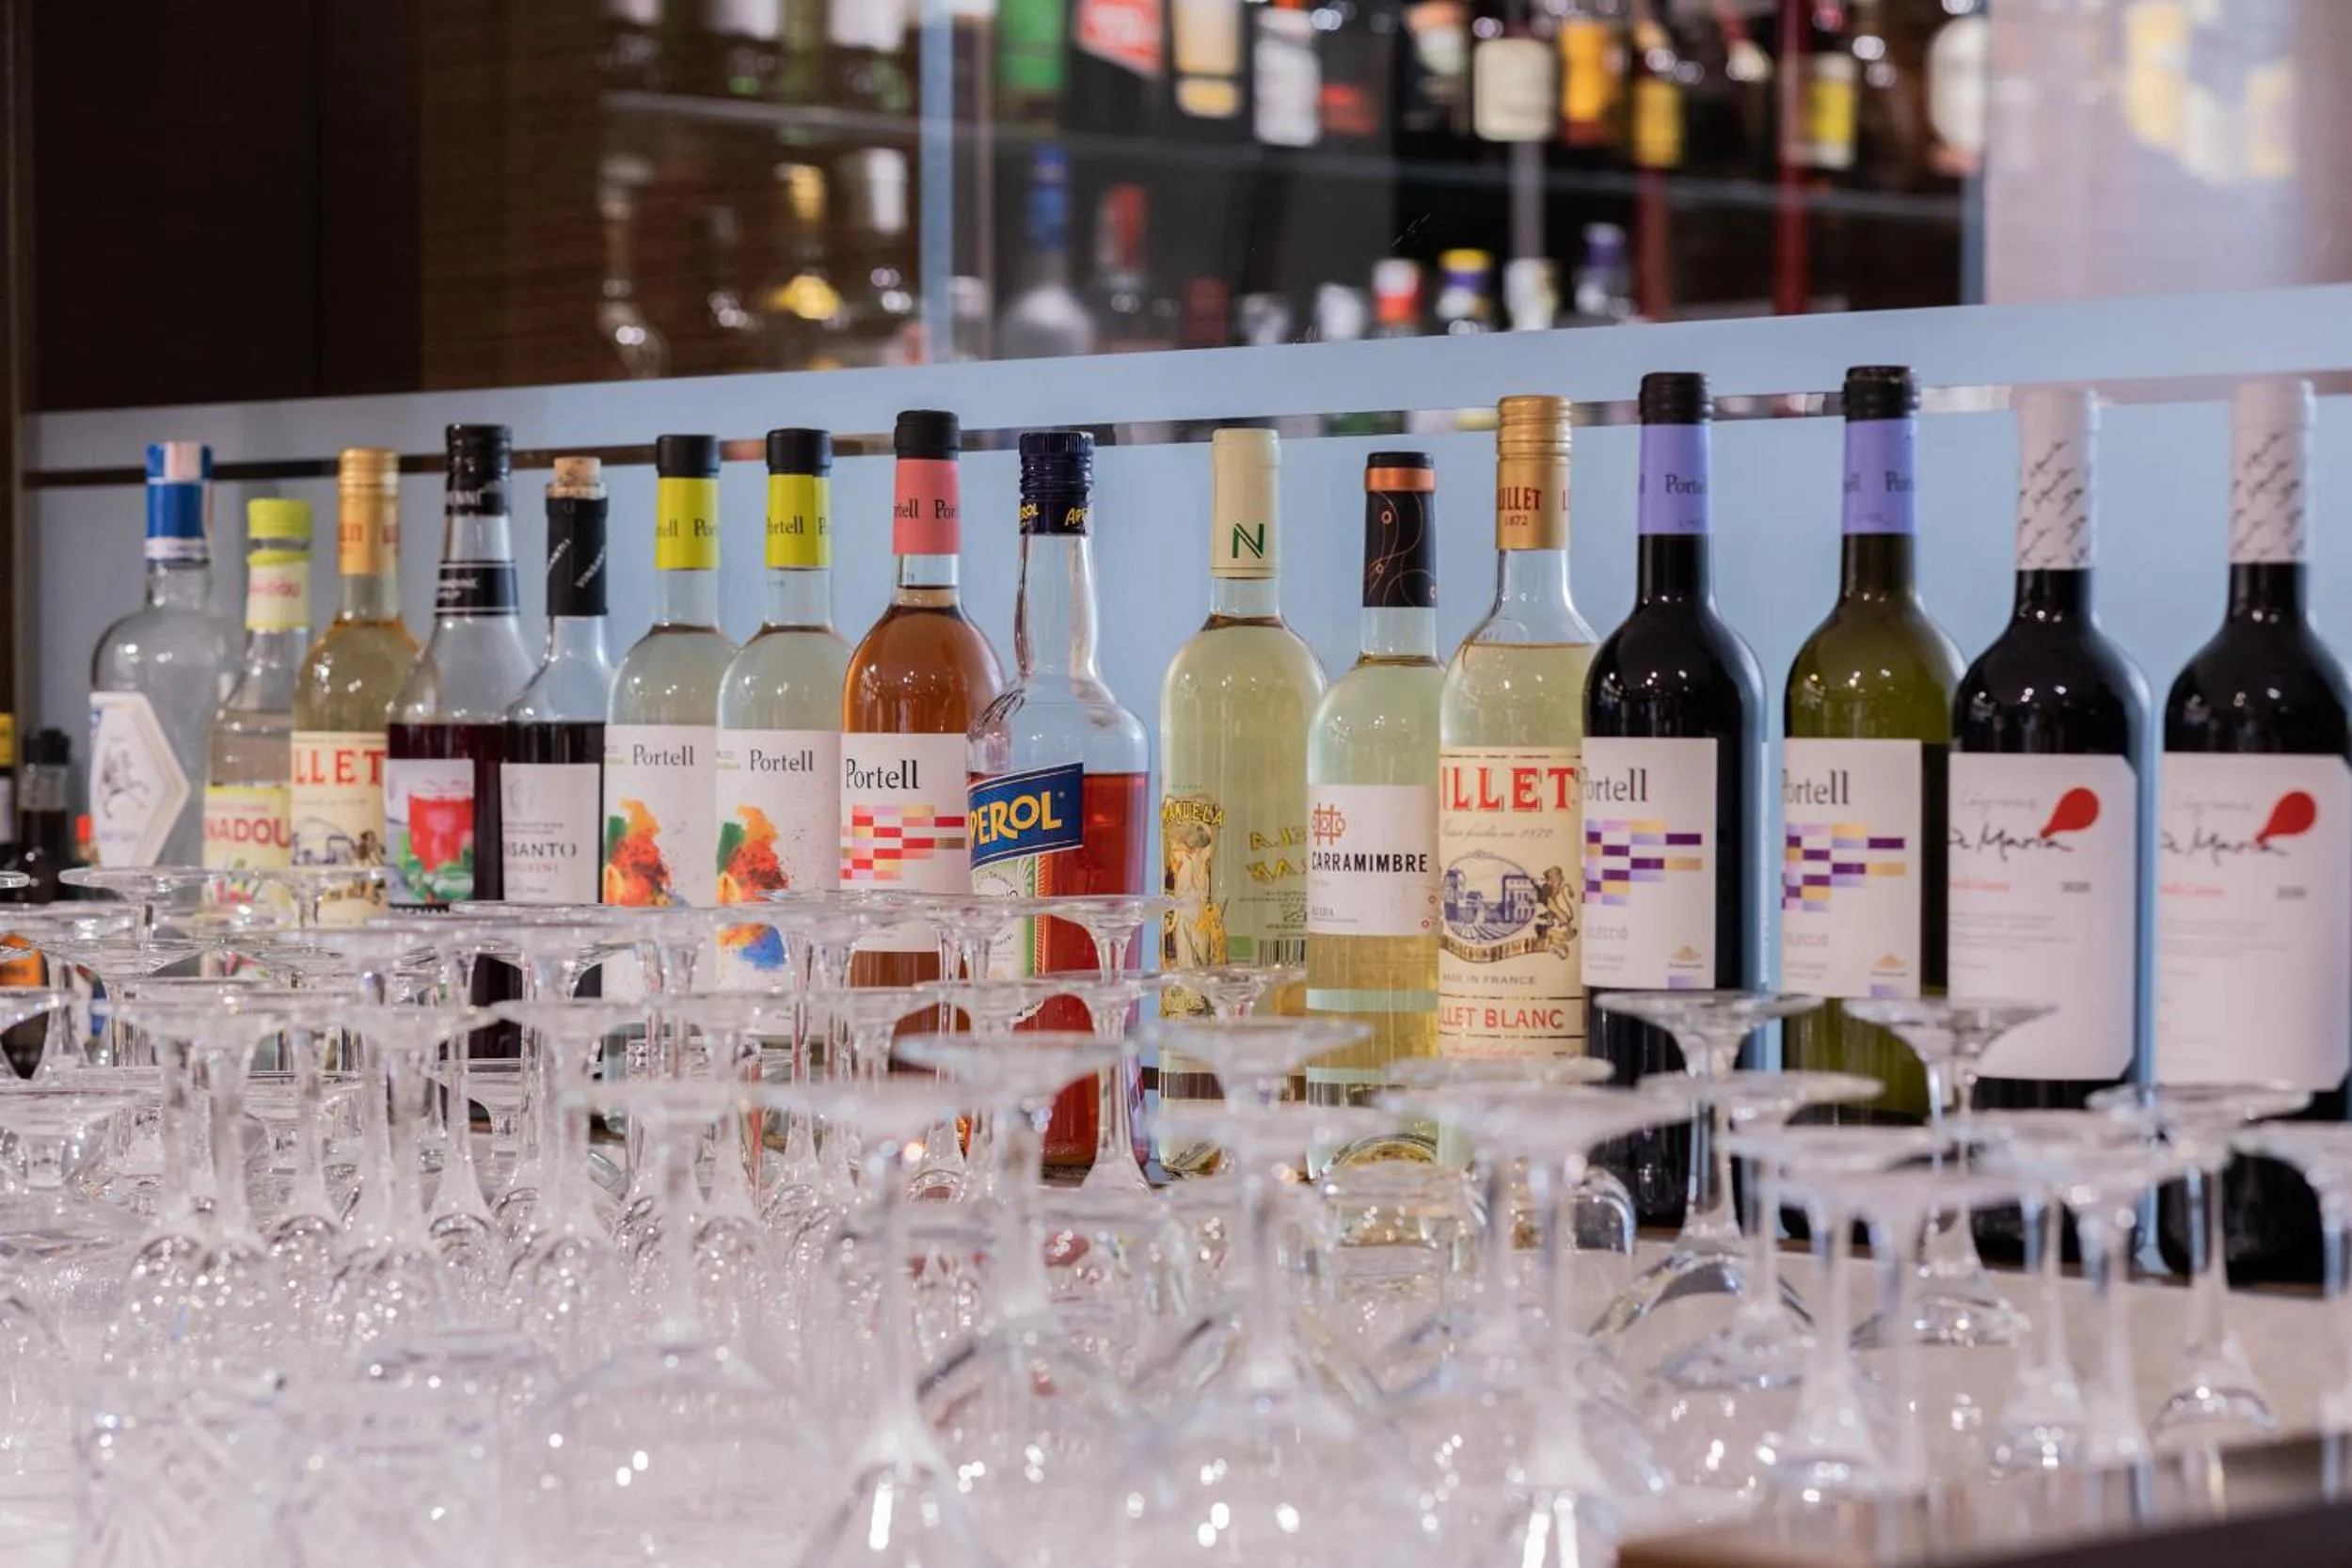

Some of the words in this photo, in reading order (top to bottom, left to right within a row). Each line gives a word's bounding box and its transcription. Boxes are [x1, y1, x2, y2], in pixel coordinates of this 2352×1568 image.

[1232, 522, 1264, 559] N
[632, 744, 695, 767] Portell
[749, 749, 815, 772] Portell
[846, 759, 920, 790] Portell
[970, 790, 1062, 850] PEROL
[1311, 851, 1428, 874] CARRAMIMBRE
[1485, 1008, 1565, 1029] BLANC
